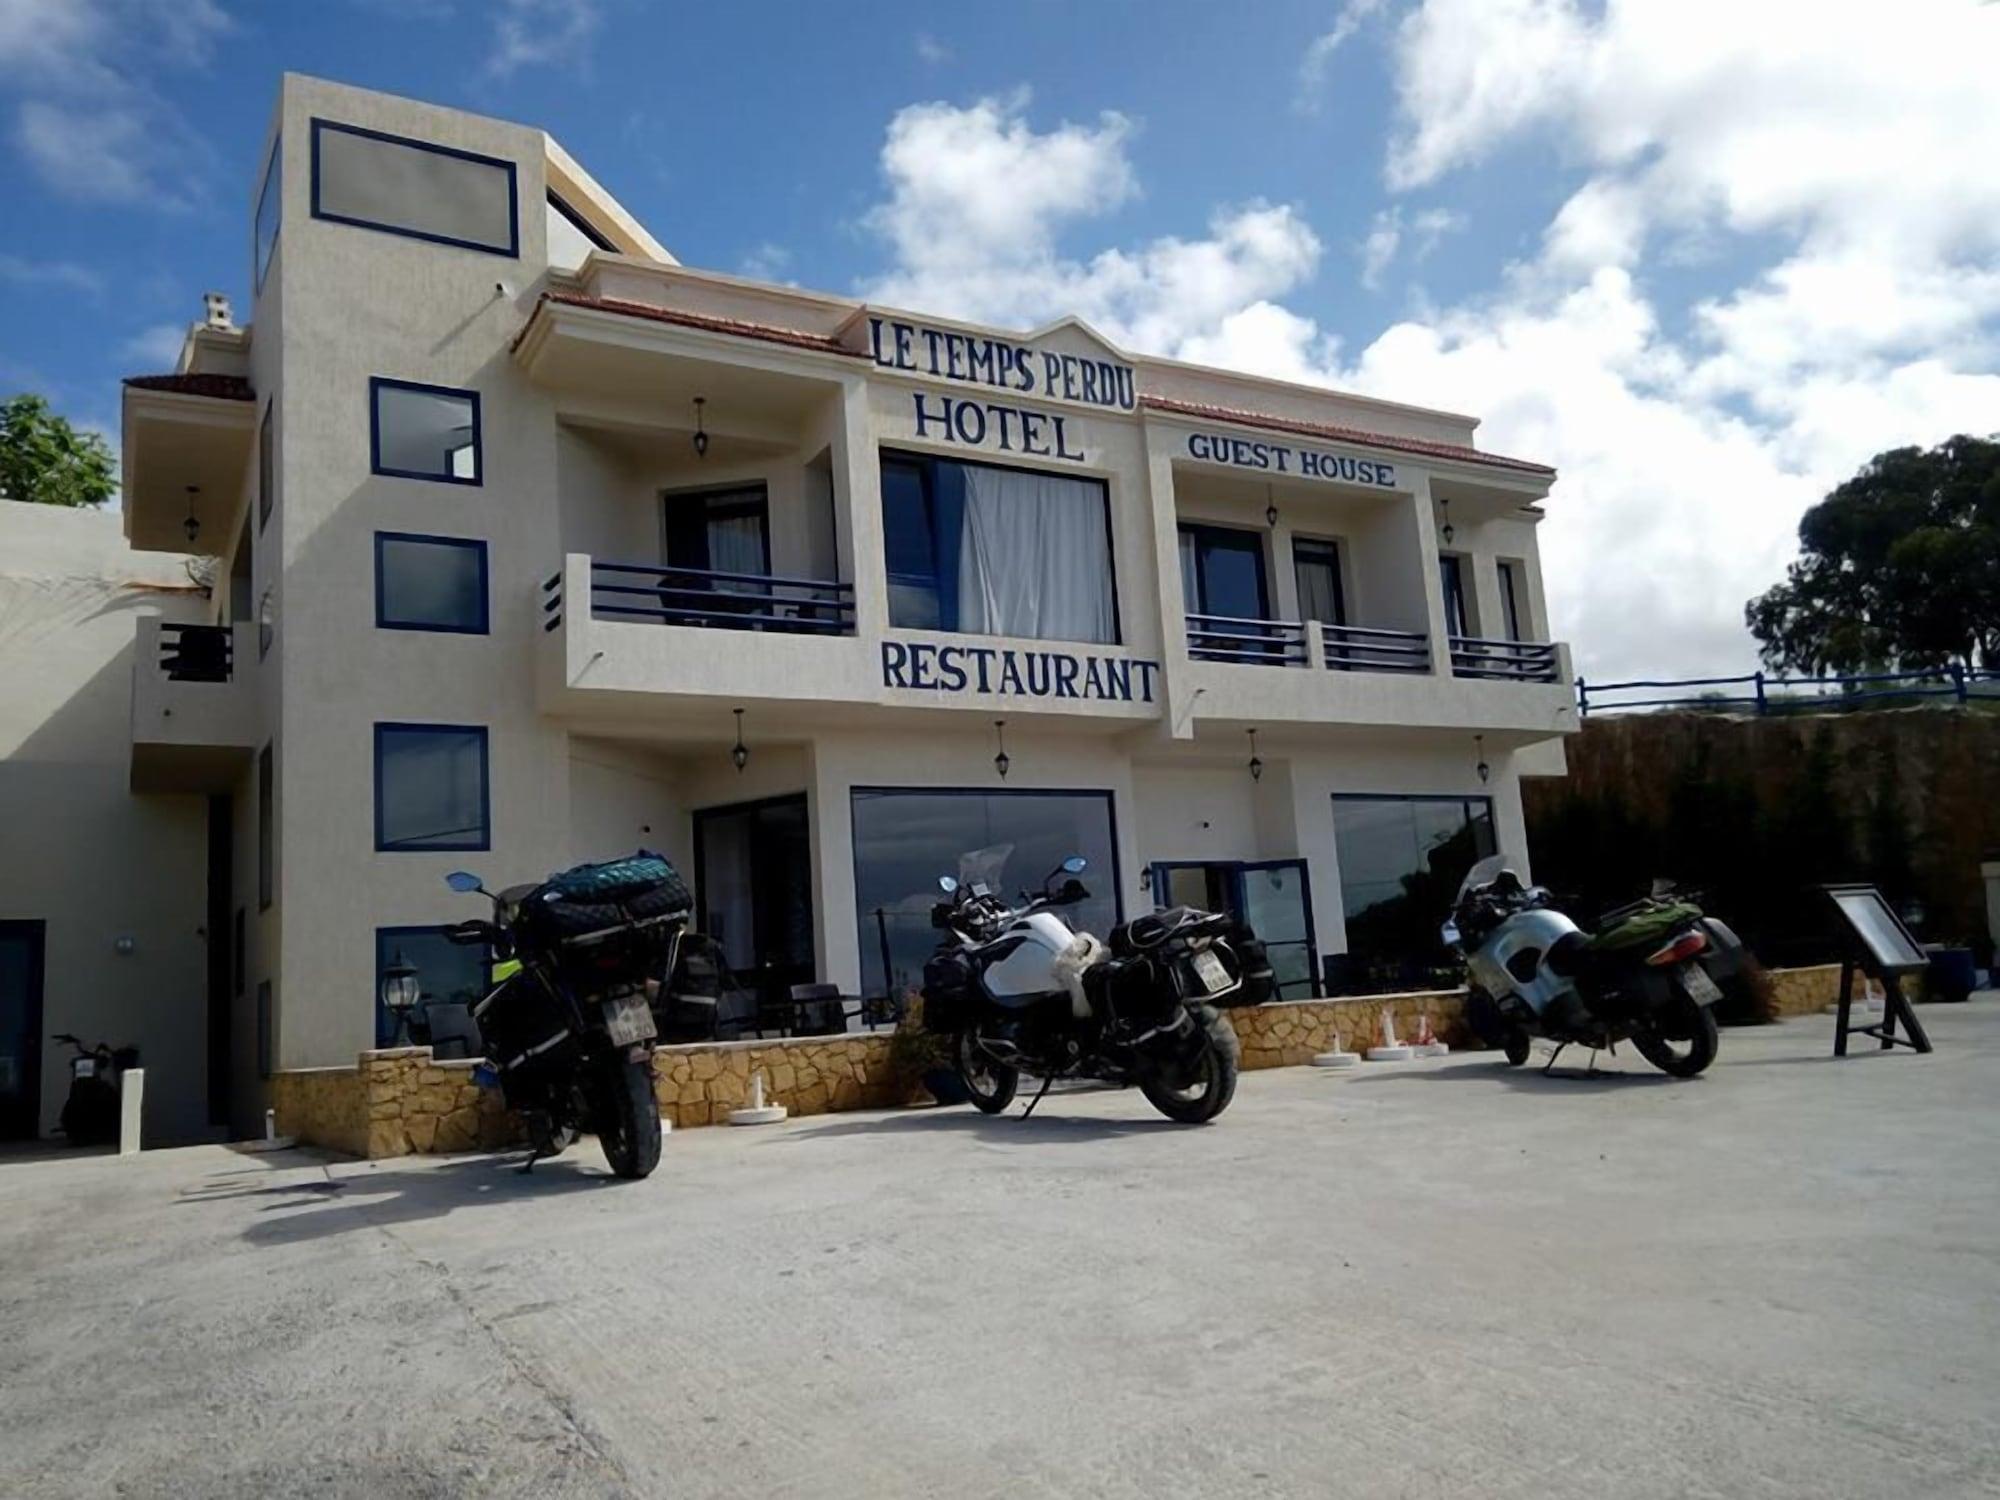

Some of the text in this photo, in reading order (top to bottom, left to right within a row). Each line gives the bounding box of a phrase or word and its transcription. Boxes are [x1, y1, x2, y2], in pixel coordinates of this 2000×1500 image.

[869, 318, 1136, 410] LE TEMPS PERDU
[913, 393, 1085, 462] HOTEL
[1188, 433, 1396, 487] GUEST HOUSE
[881, 641, 1159, 702] RESTAURANT
